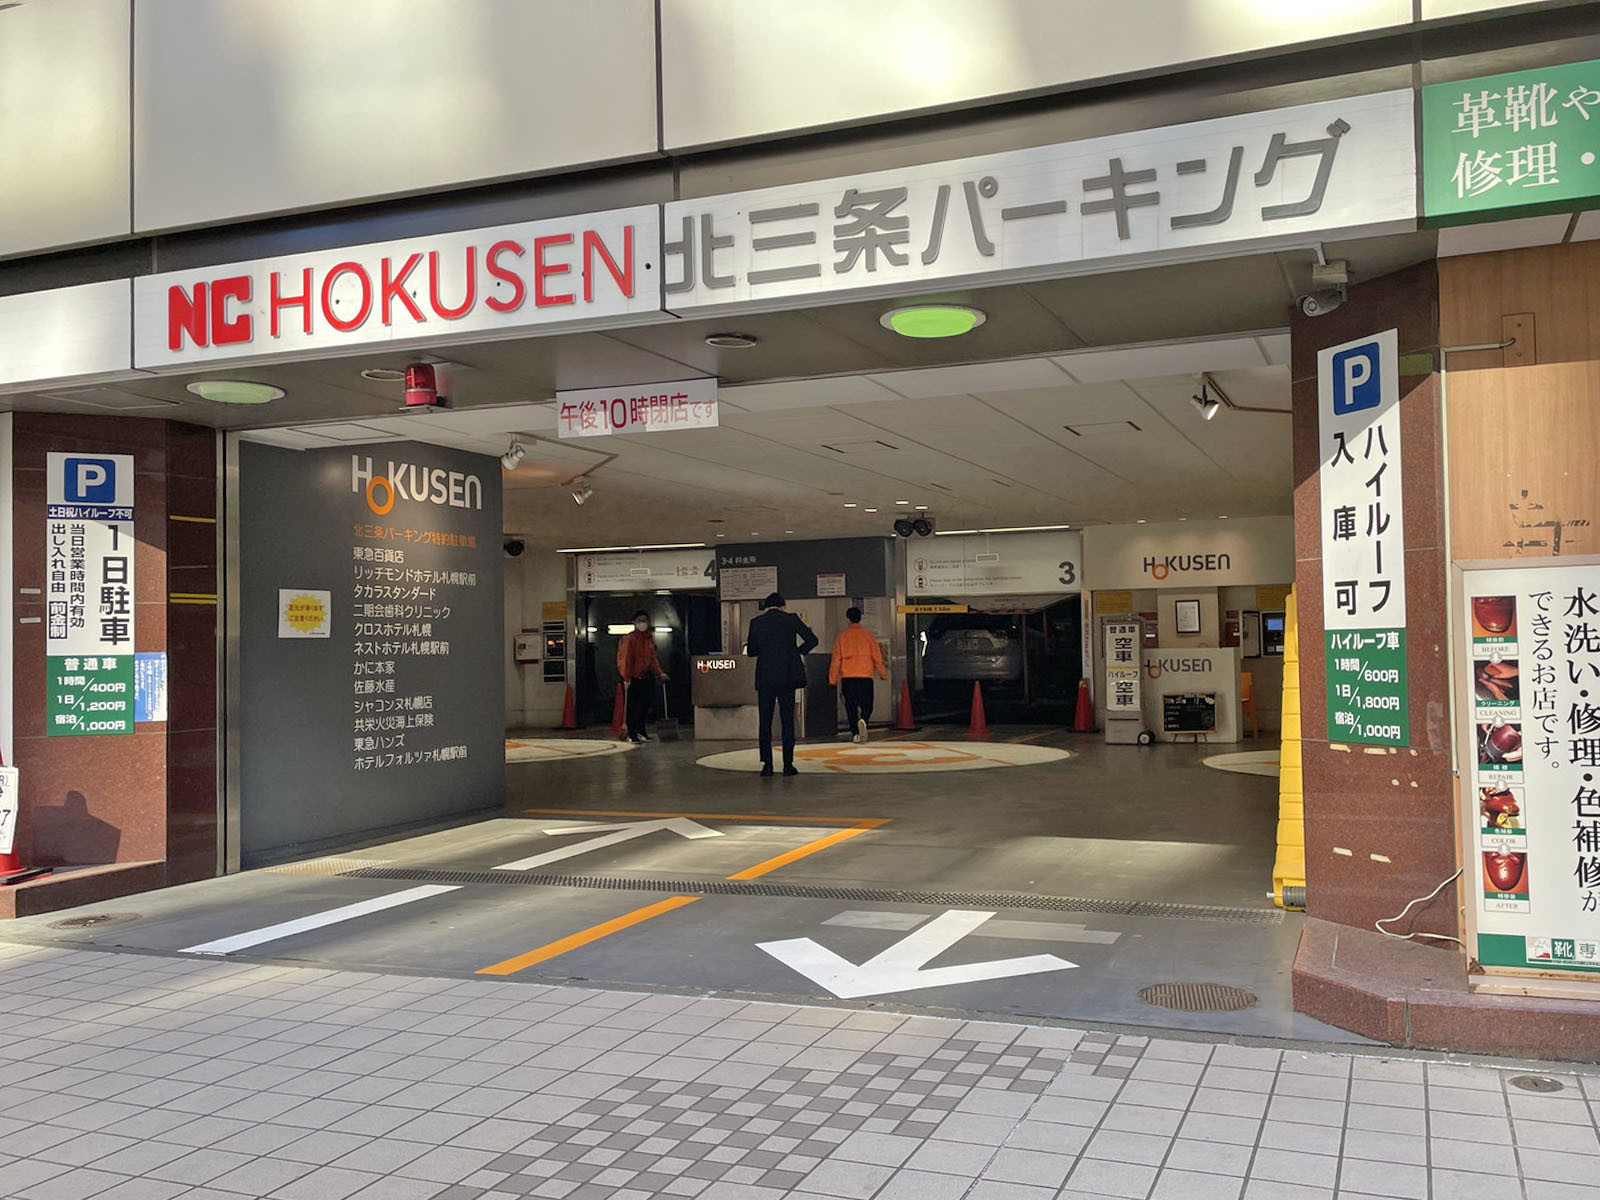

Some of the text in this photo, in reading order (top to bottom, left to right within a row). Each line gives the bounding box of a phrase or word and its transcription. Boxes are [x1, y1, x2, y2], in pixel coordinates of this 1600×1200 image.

[664, 118, 1349, 294] 北三条パーキング
[168, 225, 636, 351] NC HOKUSEN
[1344, 354, 1371, 405] P
[560, 392, 716, 431] 午後10時閉店です
[77, 464, 107, 498] P
[352, 455, 482, 515] HOKUSEN
[48, 507, 133, 519] 土日祝ハイルーフ不可
[1331, 432, 1358, 615] 入庫可
[1364, 424, 1391, 614] ハイルーフ
[51, 523, 66, 593] 出し入れ自由
[353, 547, 404, 563] 東急百貨店
[70, 523, 86, 628] 当日営業時間内有効
[354, 565, 477, 586] リッチモンドホテル札幌駅前
[704, 559, 716, 580] 4
[1058, 561, 1076, 585] 3
[1144, 553, 1231, 580] HOKUSEN
[99, 524, 131, 647] 1日駐車
[354, 584, 437, 600] タカラスタンダード
[353, 603, 451, 619] 二期会歯科クリニック
[354, 622, 432, 637] クロスホテル札幌
[354, 641, 449, 655] ネストホテル札幌駅前
[1114, 637, 1133, 663] 空車
[1331, 632, 1400, 650] ハイルーフ車
[64, 657, 117, 671] 普通車
[354, 661, 395, 675] かに本家
[697, 660, 736, 673] HOKUSEN
[1108, 671, 1138, 679] ハイルーフ
[354, 679, 395, 694] 佐藤水産
[1115, 681, 1133, 706] 空車
[354, 696, 432, 713] シャコンヌ札幌店
[354, 714, 434, 732] 共栄火災海上保険
[353, 733, 405, 751] 東急ハンズ
[354, 746, 467, 770] ホテルフォルツァ札幌駅前
